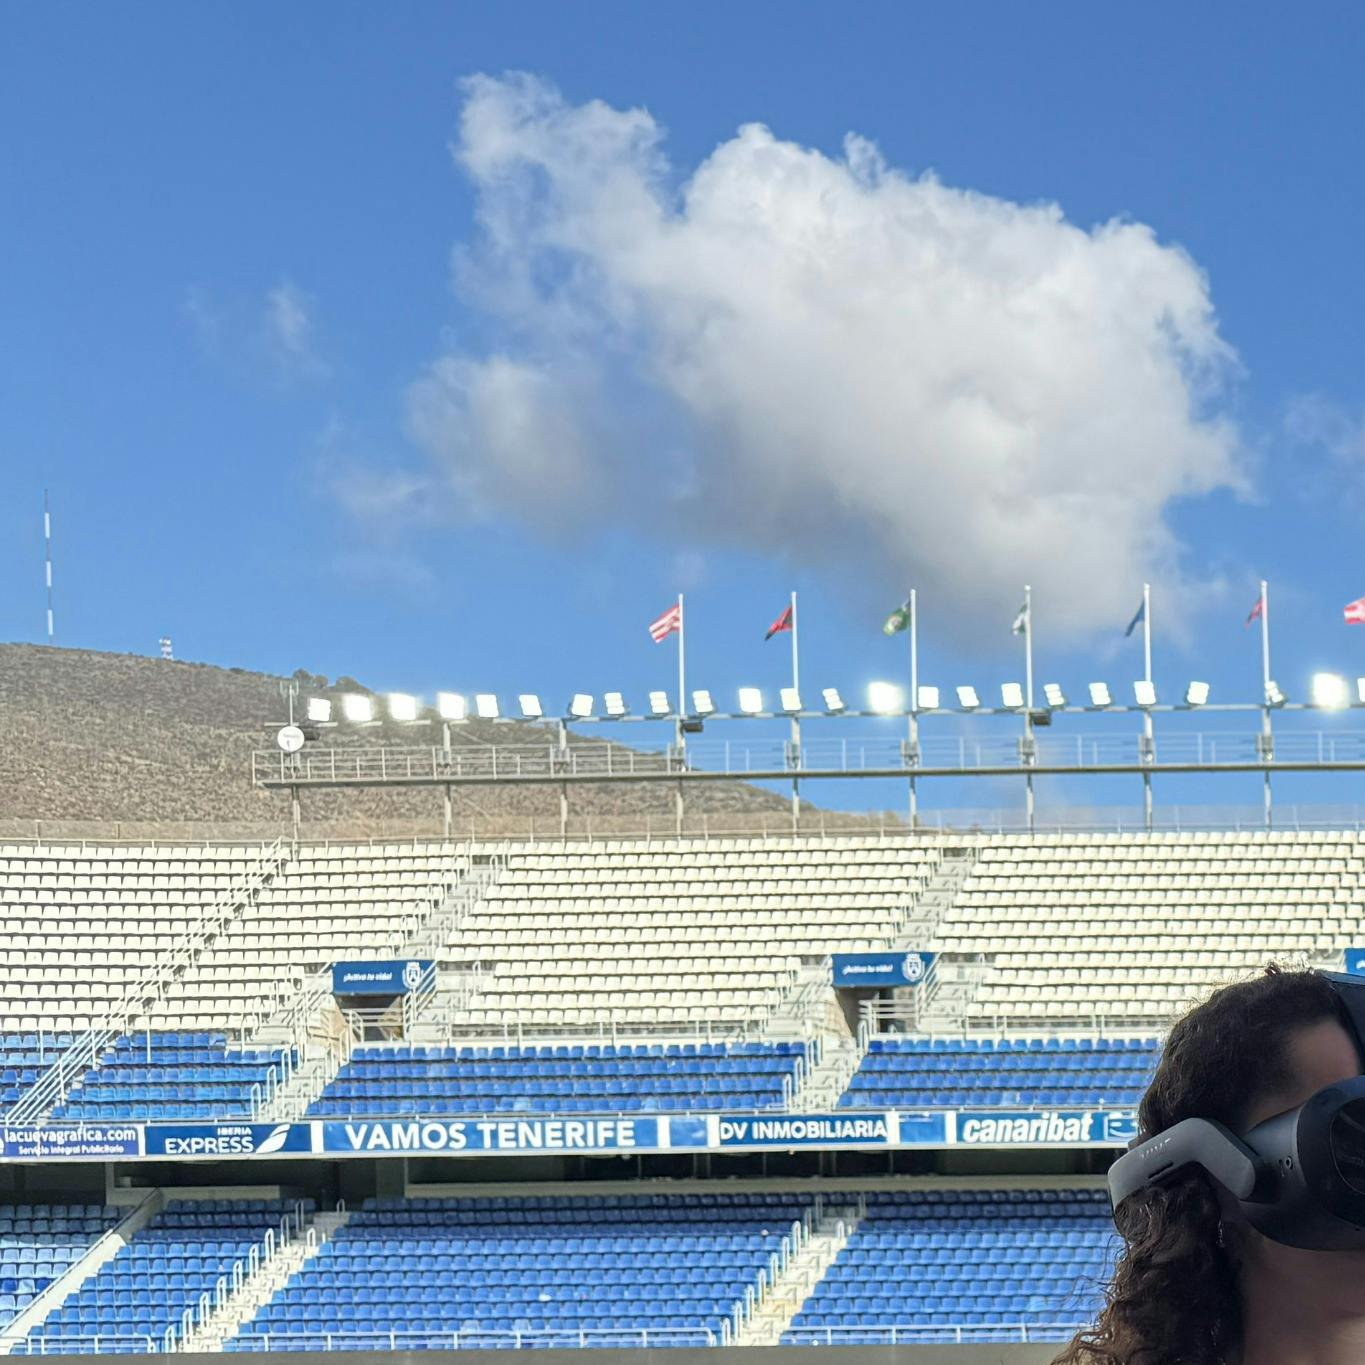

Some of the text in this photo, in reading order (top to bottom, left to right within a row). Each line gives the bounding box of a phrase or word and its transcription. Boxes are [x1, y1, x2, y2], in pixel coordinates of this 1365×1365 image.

[4, 1127, 136, 1145] lacuevagrafica.com
[217, 1127, 252, 1136] IBERIA
[345, 1121, 635, 1149] VAMOS TENERIFE
[720, 1120, 888, 1140] DV INMOBILIARIA
[963, 1112, 1093, 1143] canaribat
[165, 1137, 254, 1154] EXPRESS
